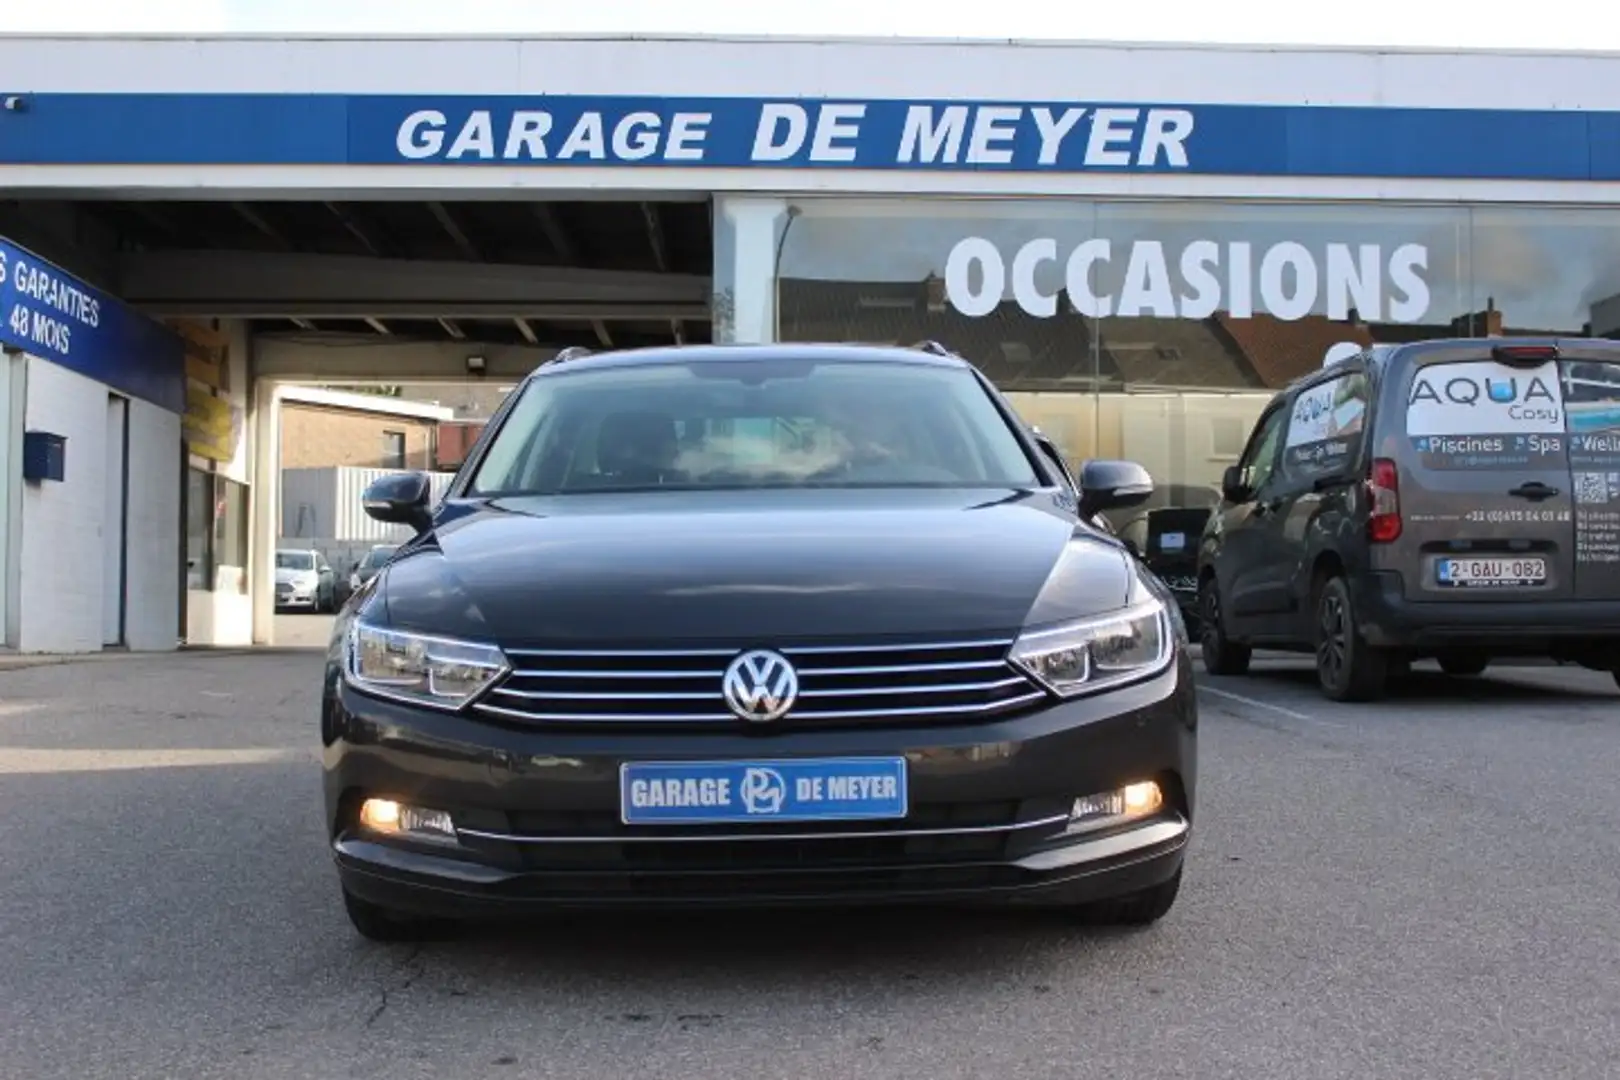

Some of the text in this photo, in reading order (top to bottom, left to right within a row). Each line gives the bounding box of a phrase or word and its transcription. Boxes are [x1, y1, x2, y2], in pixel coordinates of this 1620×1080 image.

[396, 103, 1194, 167] GARAGE DE MEYER
[14, 260, 100, 328] GARANTIES
[944, 236, 1430, 322] OCCASIONS
[9, 303, 71, 355] 48 MOIS
[1409, 376, 1555, 406] AQUA
[1507, 404, 1559, 424] Cosy
[1429, 436, 1504, 453] Piscines
[1527, 434, 1561, 456] Spa
[630, 778, 731, 808] GARAGE
[795, 777, 823, 801] DE
[828, 775, 897, 801] MEYER
